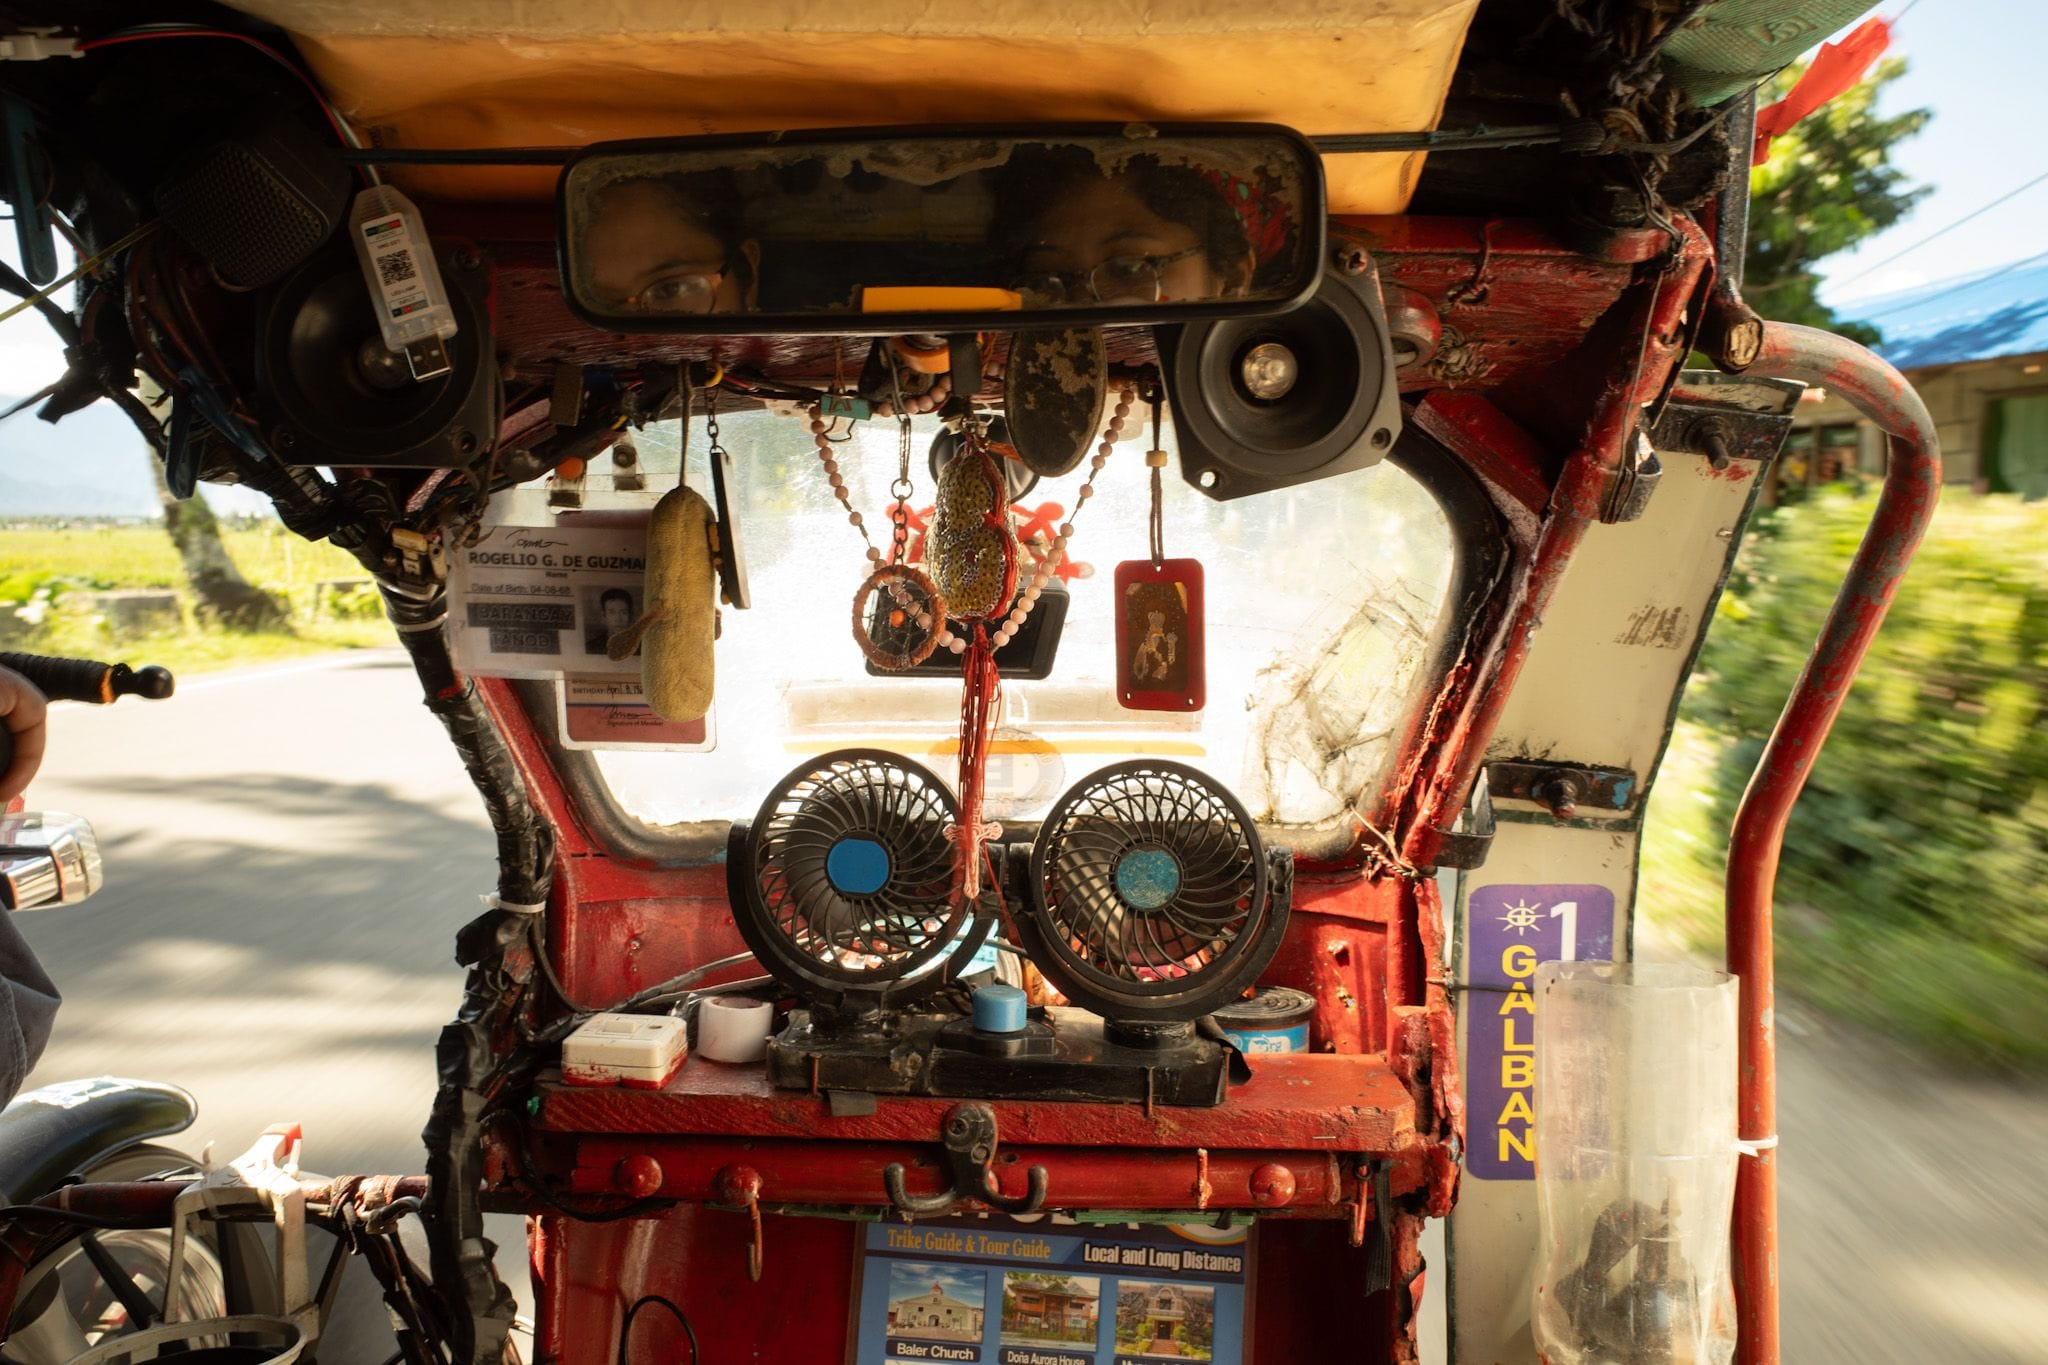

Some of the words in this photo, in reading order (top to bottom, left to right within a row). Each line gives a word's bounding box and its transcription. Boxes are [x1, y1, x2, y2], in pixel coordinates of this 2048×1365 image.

[469, 552, 538, 566] ROGELIO
[542, 554, 557, 567] G.
[562, 555, 583, 568] DE
[586, 556, 646, 570] GUZMA
[479, 604, 573, 622] BARANGAY
[1497, 944, 1537, 1162] GALBAN
[888, 1228, 922, 1249] Trike
[925, 1232, 963, 1252] Guide
[966, 1235, 975, 1253] &
[978, 1235, 1010, 1256] Tour
[1012, 1238, 1051, 1258] Guide
[1084, 1243, 1119, 1264] Local
[1122, 1248, 1146, 1266] and
[1149, 1248, 1180, 1270] Long
[1183, 1250, 1242, 1273] Distance
[896, 1343, 928, 1357] Baler
[930, 1344, 974, 1361] Church
[1007, 1350, 1029, 1364] Doña
[1031, 1352, 1058, 1365] Aurora
[1059, 1353, 1086, 1365] House
